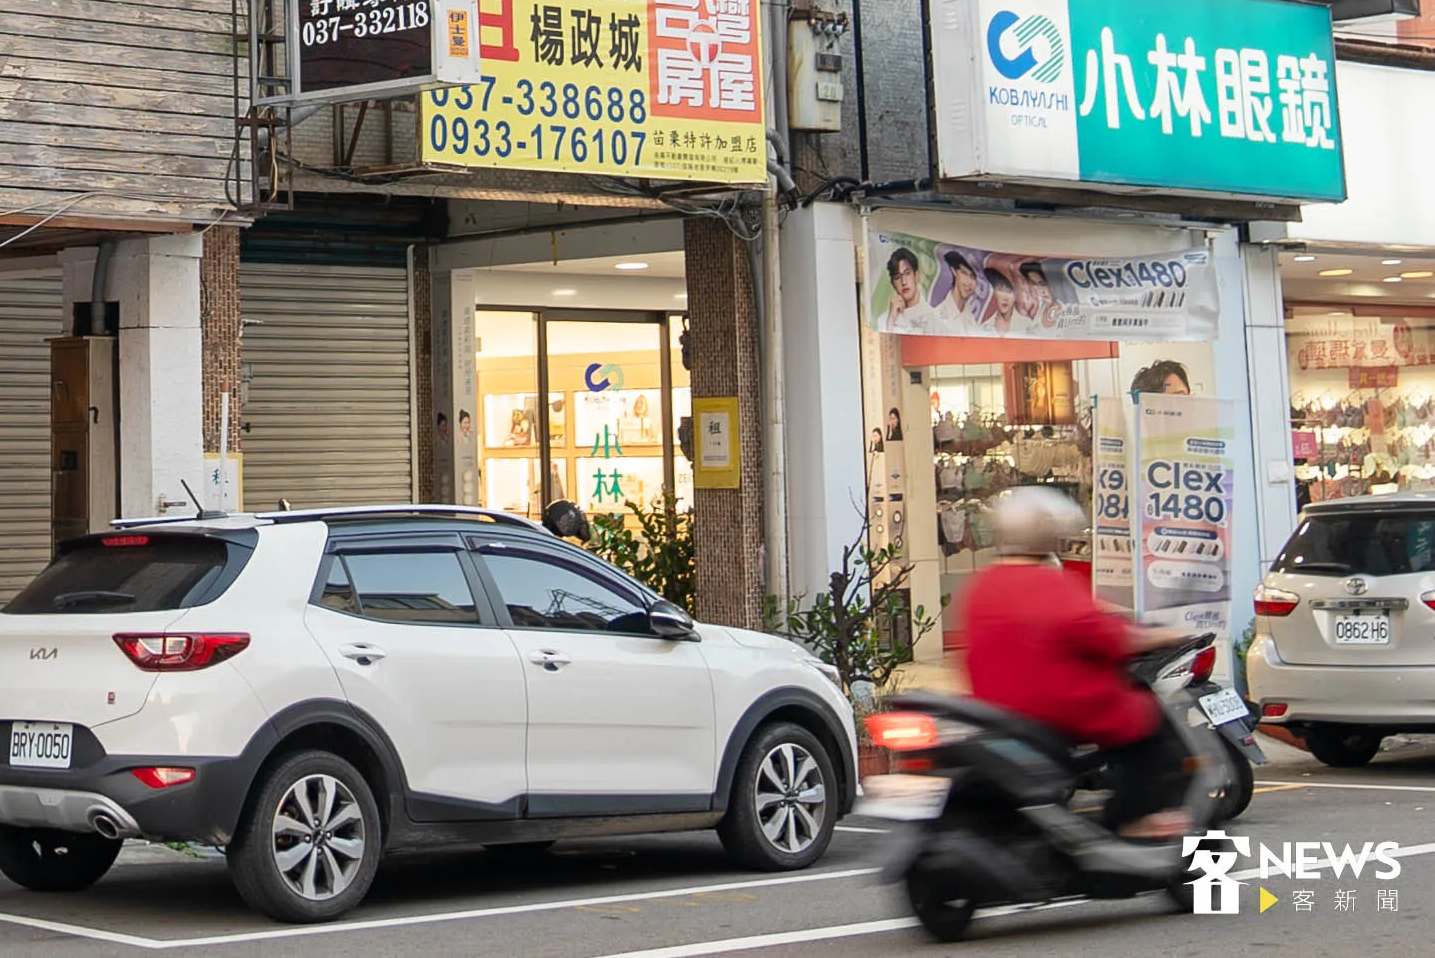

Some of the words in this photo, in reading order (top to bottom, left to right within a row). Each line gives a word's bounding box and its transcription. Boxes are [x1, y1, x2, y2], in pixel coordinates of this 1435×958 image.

[302, 1, 429, 46] 037-332118
[530, 4, 643, 73] 楊政城
[657, 48, 756, 112] 房屋
[989, 86, 1069, 111] KOBAYASHI
[1079, 26, 1335, 149] 小林眼鏡
[431, 75, 647, 125] 037-338688
[431, 114, 647, 166] 0933-176107
[1011, 114, 1048, 129] OPTICAL
[654, 130, 758, 153] 苗栗特許加盟店
[591, 423, 625, 504] 小林
[1147, 461, 1224, 494] Clex
[1149, 492, 1225, 523] 1480
[29, 647, 59, 660] KIA
[11, 731, 70, 760] BRY-0050
